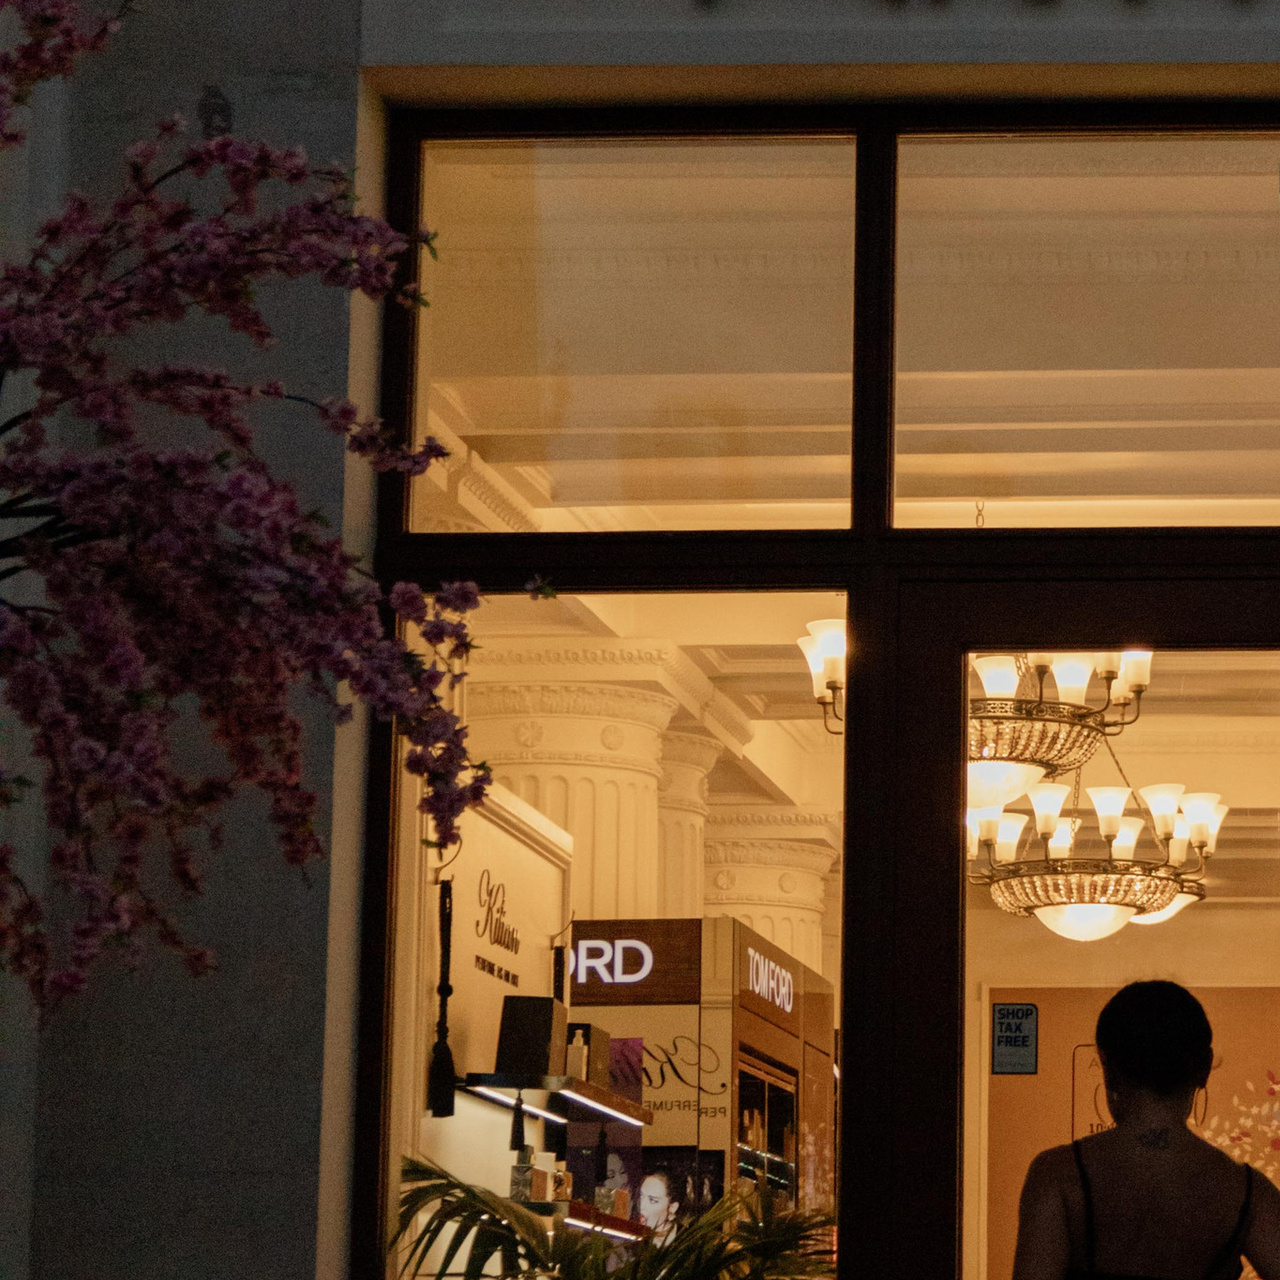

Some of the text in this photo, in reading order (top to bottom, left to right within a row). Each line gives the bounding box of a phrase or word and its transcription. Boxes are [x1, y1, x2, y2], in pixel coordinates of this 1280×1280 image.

[569, 938, 654, 984] RD
[997, 1008, 1034, 1020] SHOP
[998, 1021, 1023, 1034] TAX
[997, 1035, 1030, 1047] FREE
